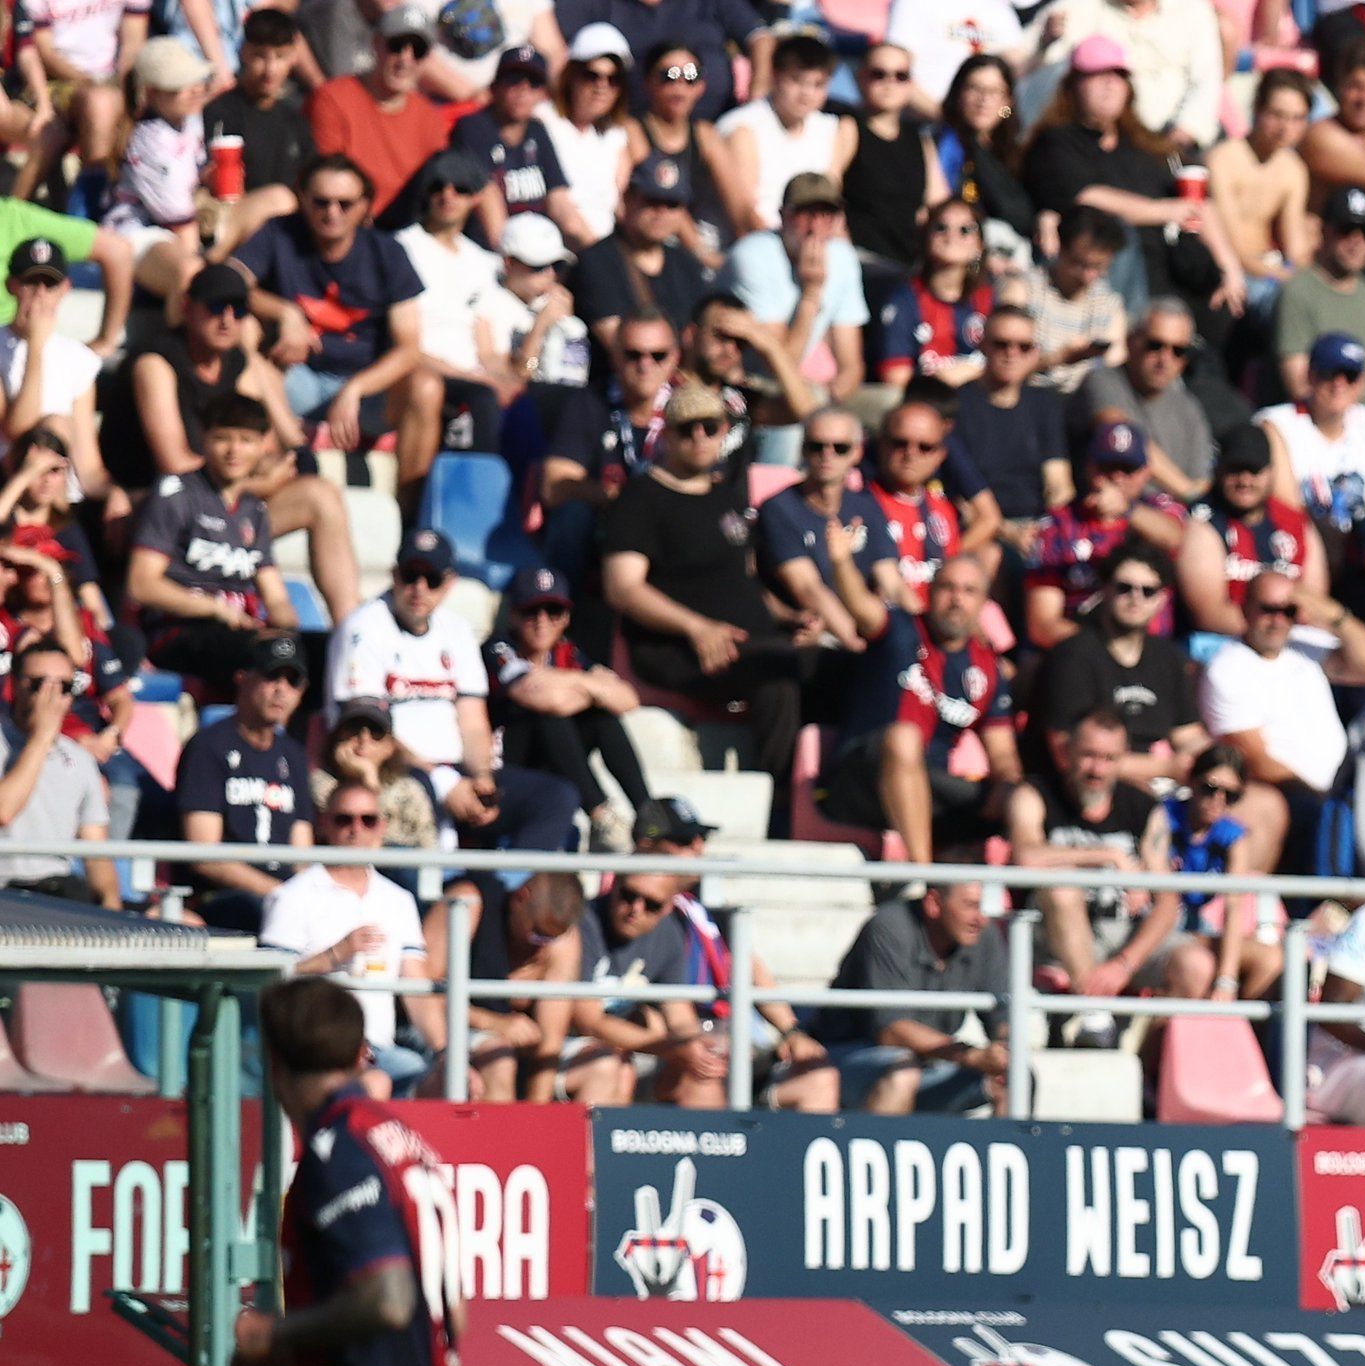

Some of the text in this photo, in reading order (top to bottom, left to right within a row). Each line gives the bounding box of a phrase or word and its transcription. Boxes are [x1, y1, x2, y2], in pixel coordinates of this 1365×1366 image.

[611, 1129, 747, 1156] BOLOGNA CLUB
[803, 1137, 1263, 1281] ARPAD WEISZ
